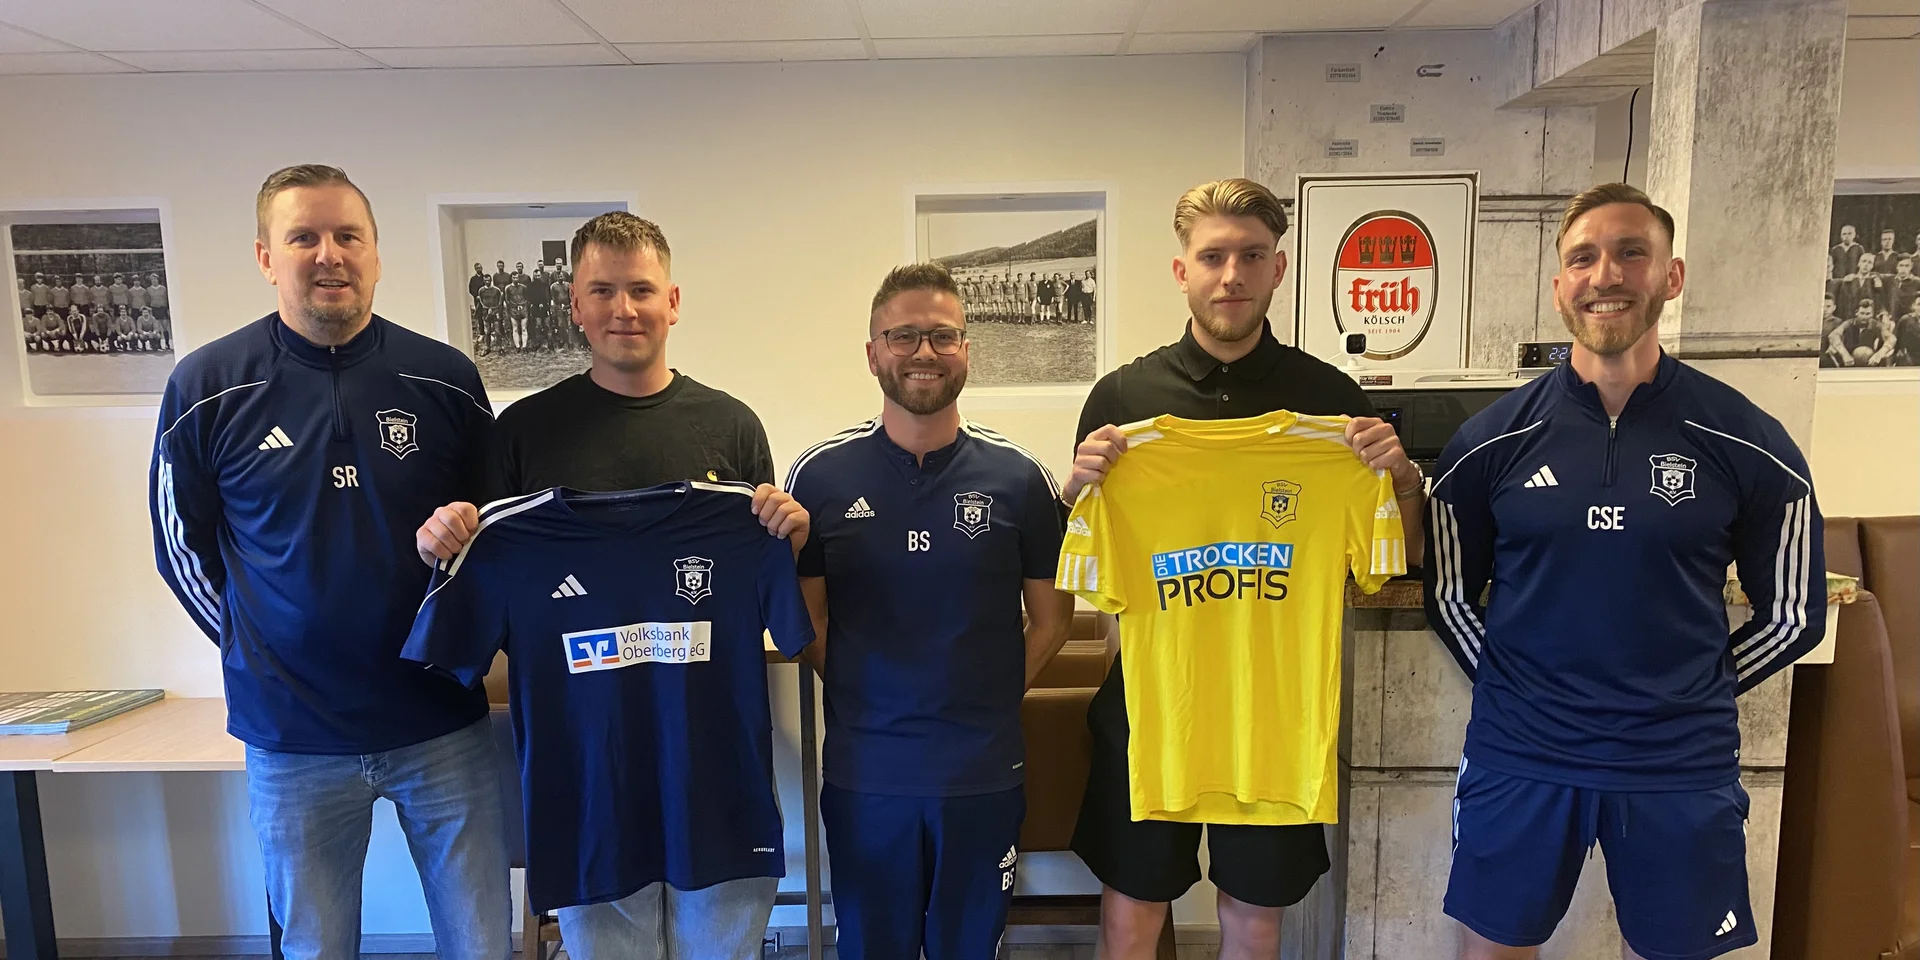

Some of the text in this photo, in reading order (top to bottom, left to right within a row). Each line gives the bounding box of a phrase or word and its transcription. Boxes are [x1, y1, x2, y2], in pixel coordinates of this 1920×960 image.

[1364, 315, 1405, 325] KÖLSCH
[1660, 461, 1687, 469] Bielstein
[332, 465, 359, 489] SR
[844, 510, 876, 519] adidas
[1587, 506, 1625, 530] CSE
[908, 530, 931, 552] BS
[1154, 543, 1290, 577] DIE TROCKEN
[1156, 568, 1290, 611] PROFIS
[620, 627, 690, 644] Volksbank
[622, 642, 705, 661] Oberberg eG
